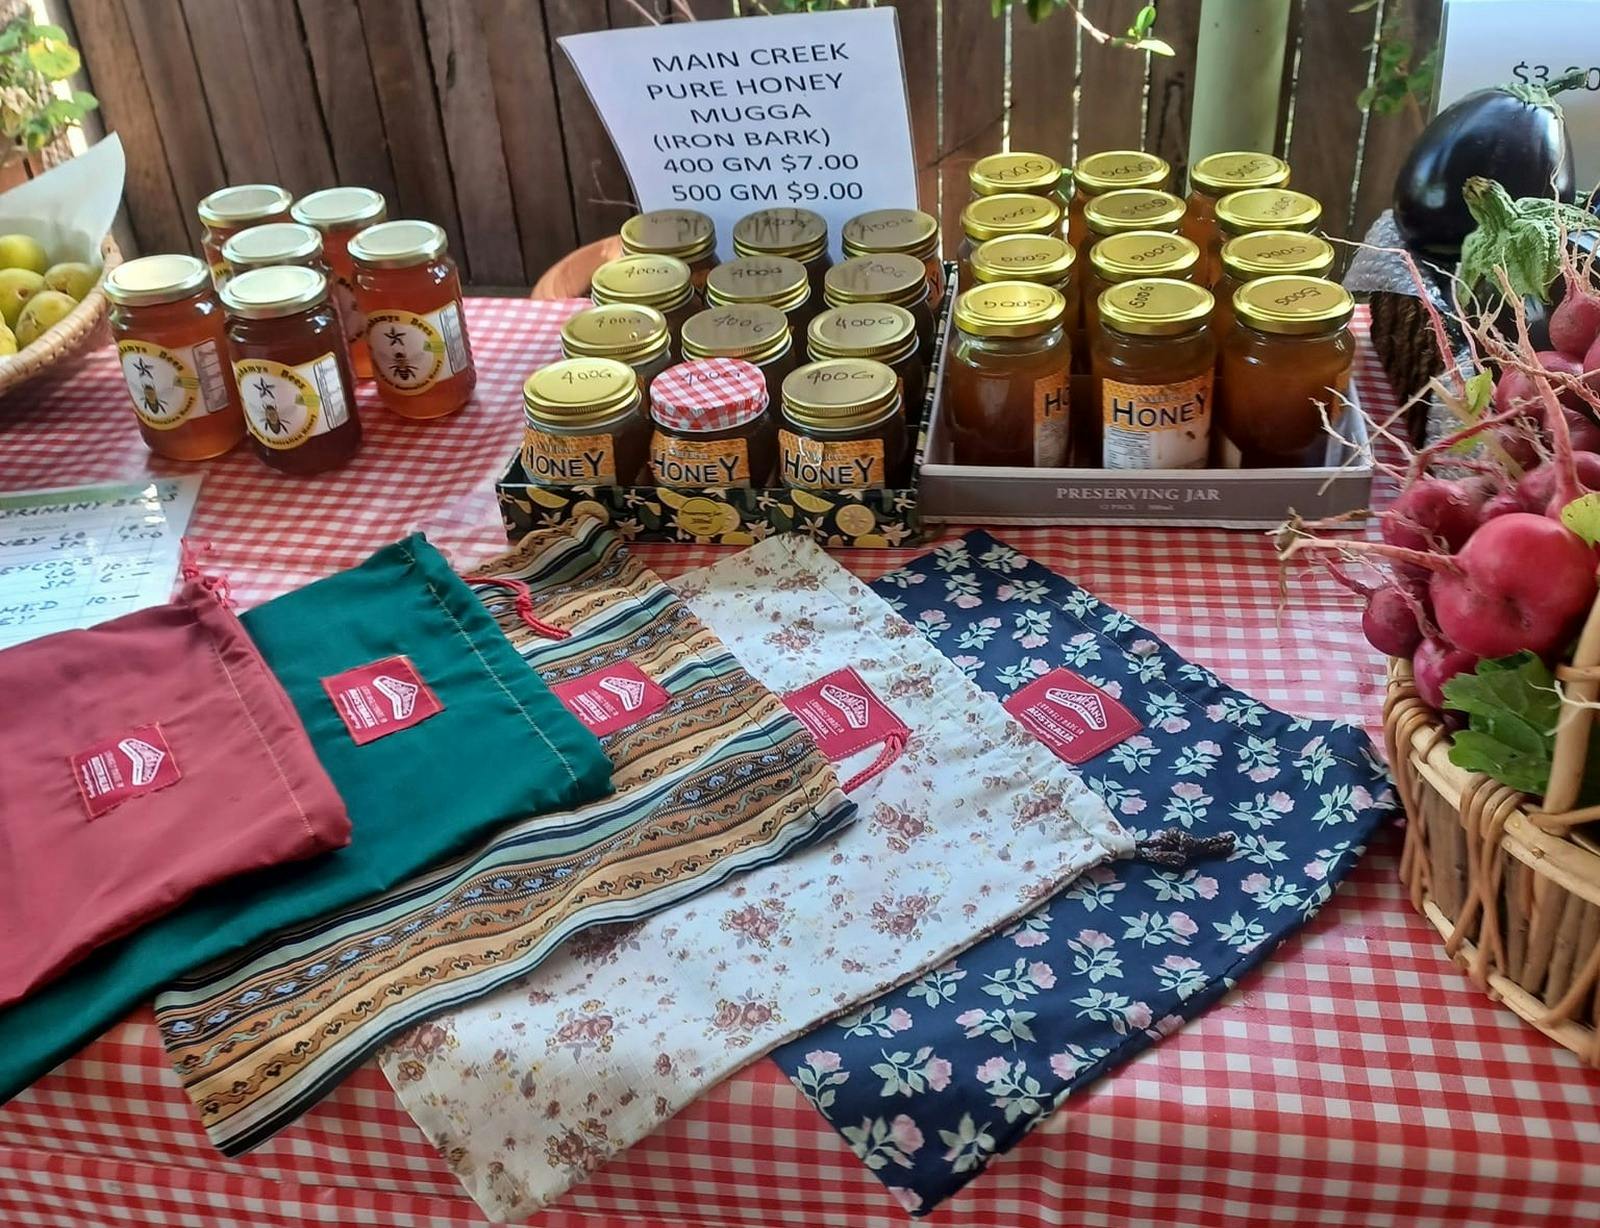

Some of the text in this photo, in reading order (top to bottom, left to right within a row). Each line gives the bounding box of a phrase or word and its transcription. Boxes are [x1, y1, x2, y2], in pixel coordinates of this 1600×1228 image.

[652, 42, 850, 73] MAIN CREEK
[647, 72, 844, 100] PURE HONEY
[690, 103, 812, 124] MUGGA
[653, 127, 831, 152] (IRON BARK)
[663, 153, 859, 174] 400 GM $7.00
[672, 181, 863, 203] 500 GM $9.00
[1113, 386, 1207, 427] HONEY
[526, 445, 604, 478] HONEY
[654, 453, 739, 483] HONEY
[785, 449, 874, 485] HONEY
[1056, 488, 1222, 503] PRESERVING JAR
[1052, 689, 1105, 726] BOOMERANG
[1026, 707, 1075, 744] AUSTRALIA
